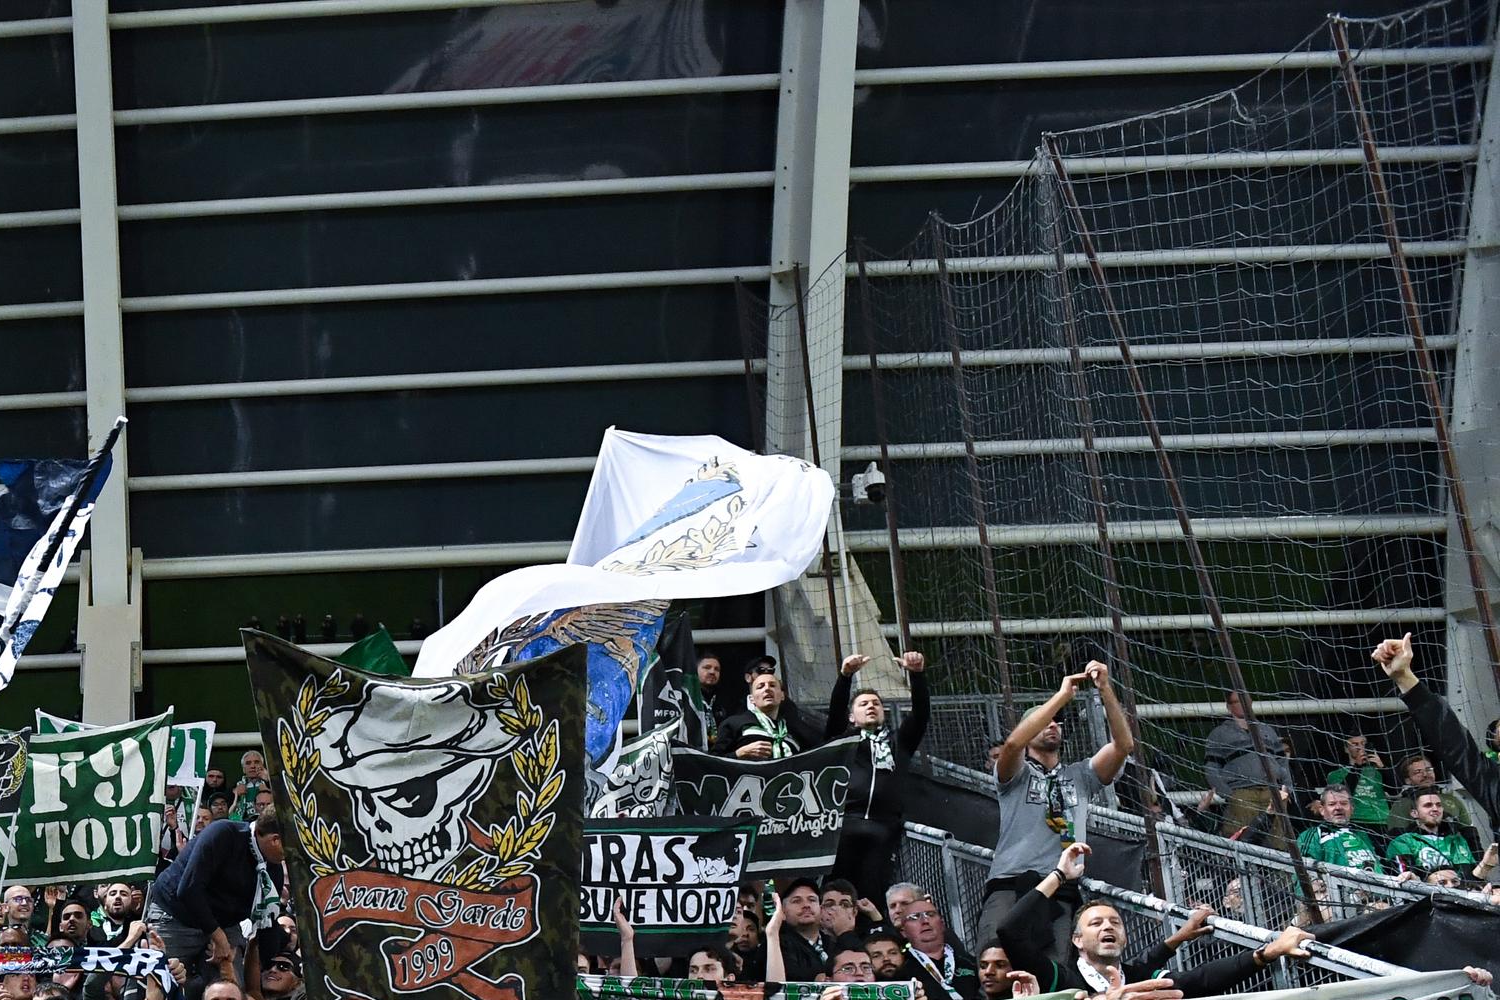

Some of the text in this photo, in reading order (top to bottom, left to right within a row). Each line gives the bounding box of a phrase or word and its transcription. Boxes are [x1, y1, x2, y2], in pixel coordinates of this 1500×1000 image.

[324, 875, 526, 931] Avant Garde
[656, 889, 736, 924] NORD
[399, 938, 455, 985] 1999
